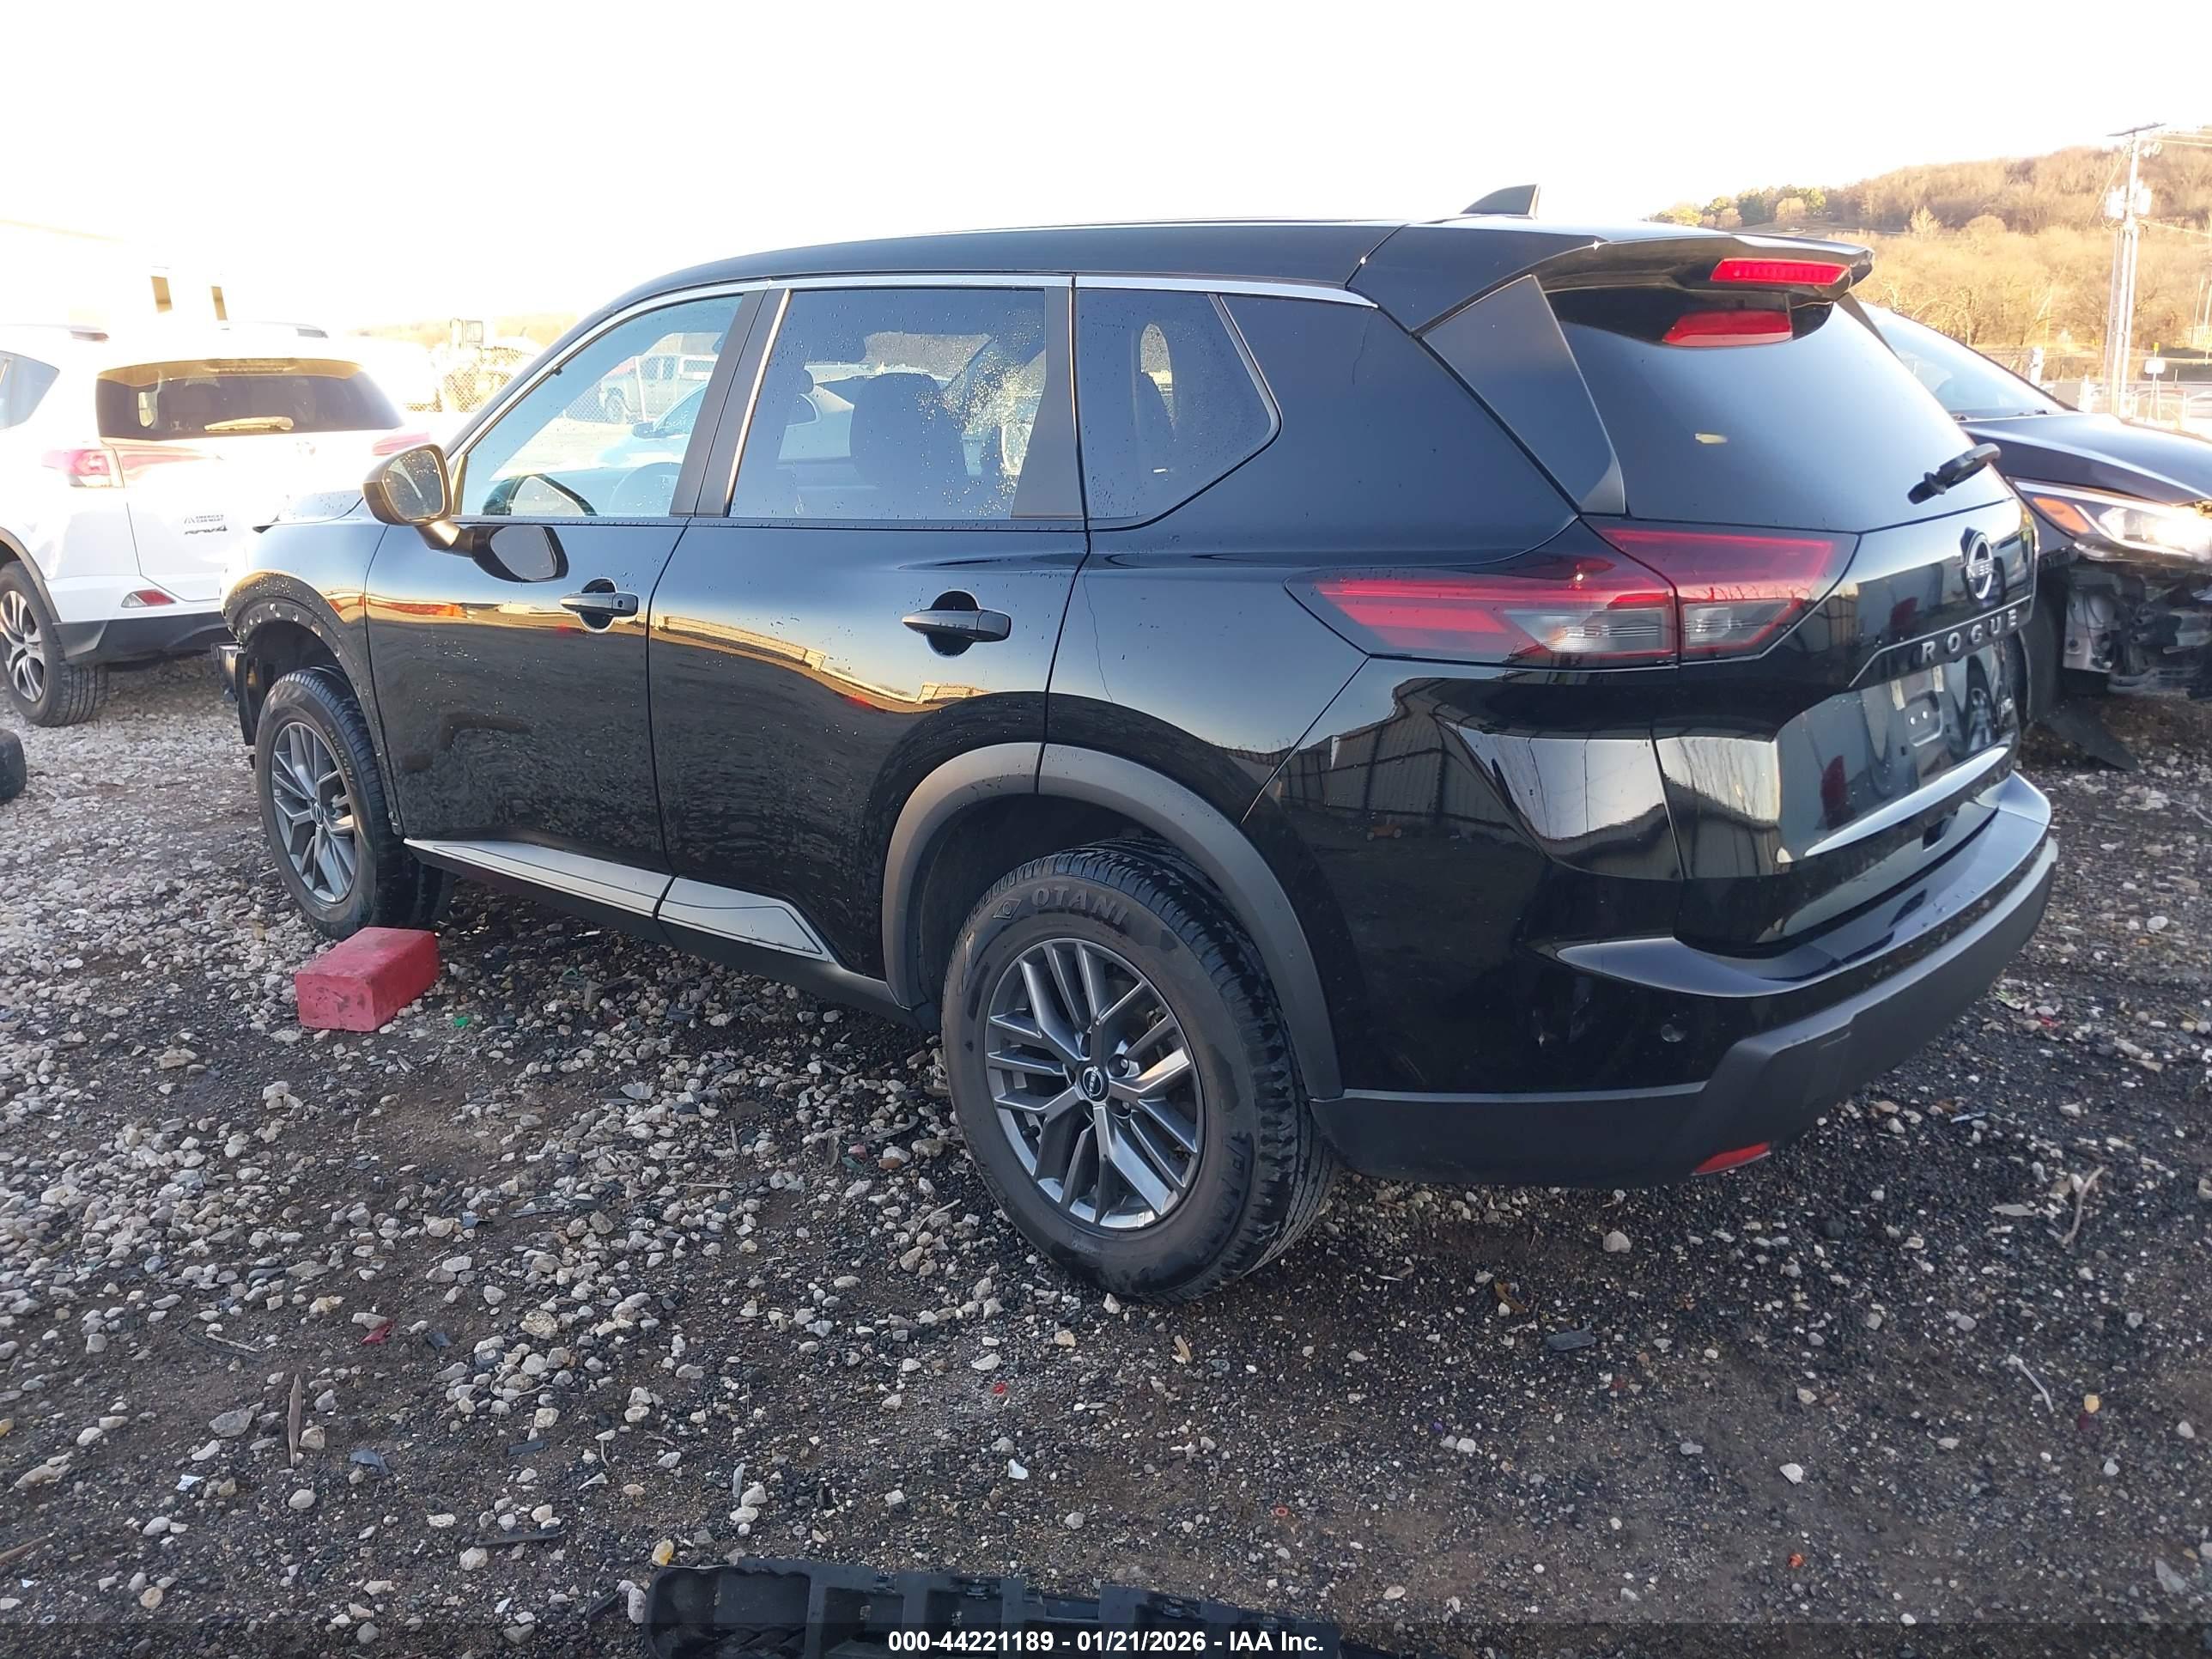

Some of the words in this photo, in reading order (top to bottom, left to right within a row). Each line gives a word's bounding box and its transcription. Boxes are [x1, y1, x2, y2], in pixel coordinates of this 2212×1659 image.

[1966, 563, 1993, 579] NSS
[1920, 608, 2018, 665] ROGUE
[1031, 885, 1129, 926] OTANI
